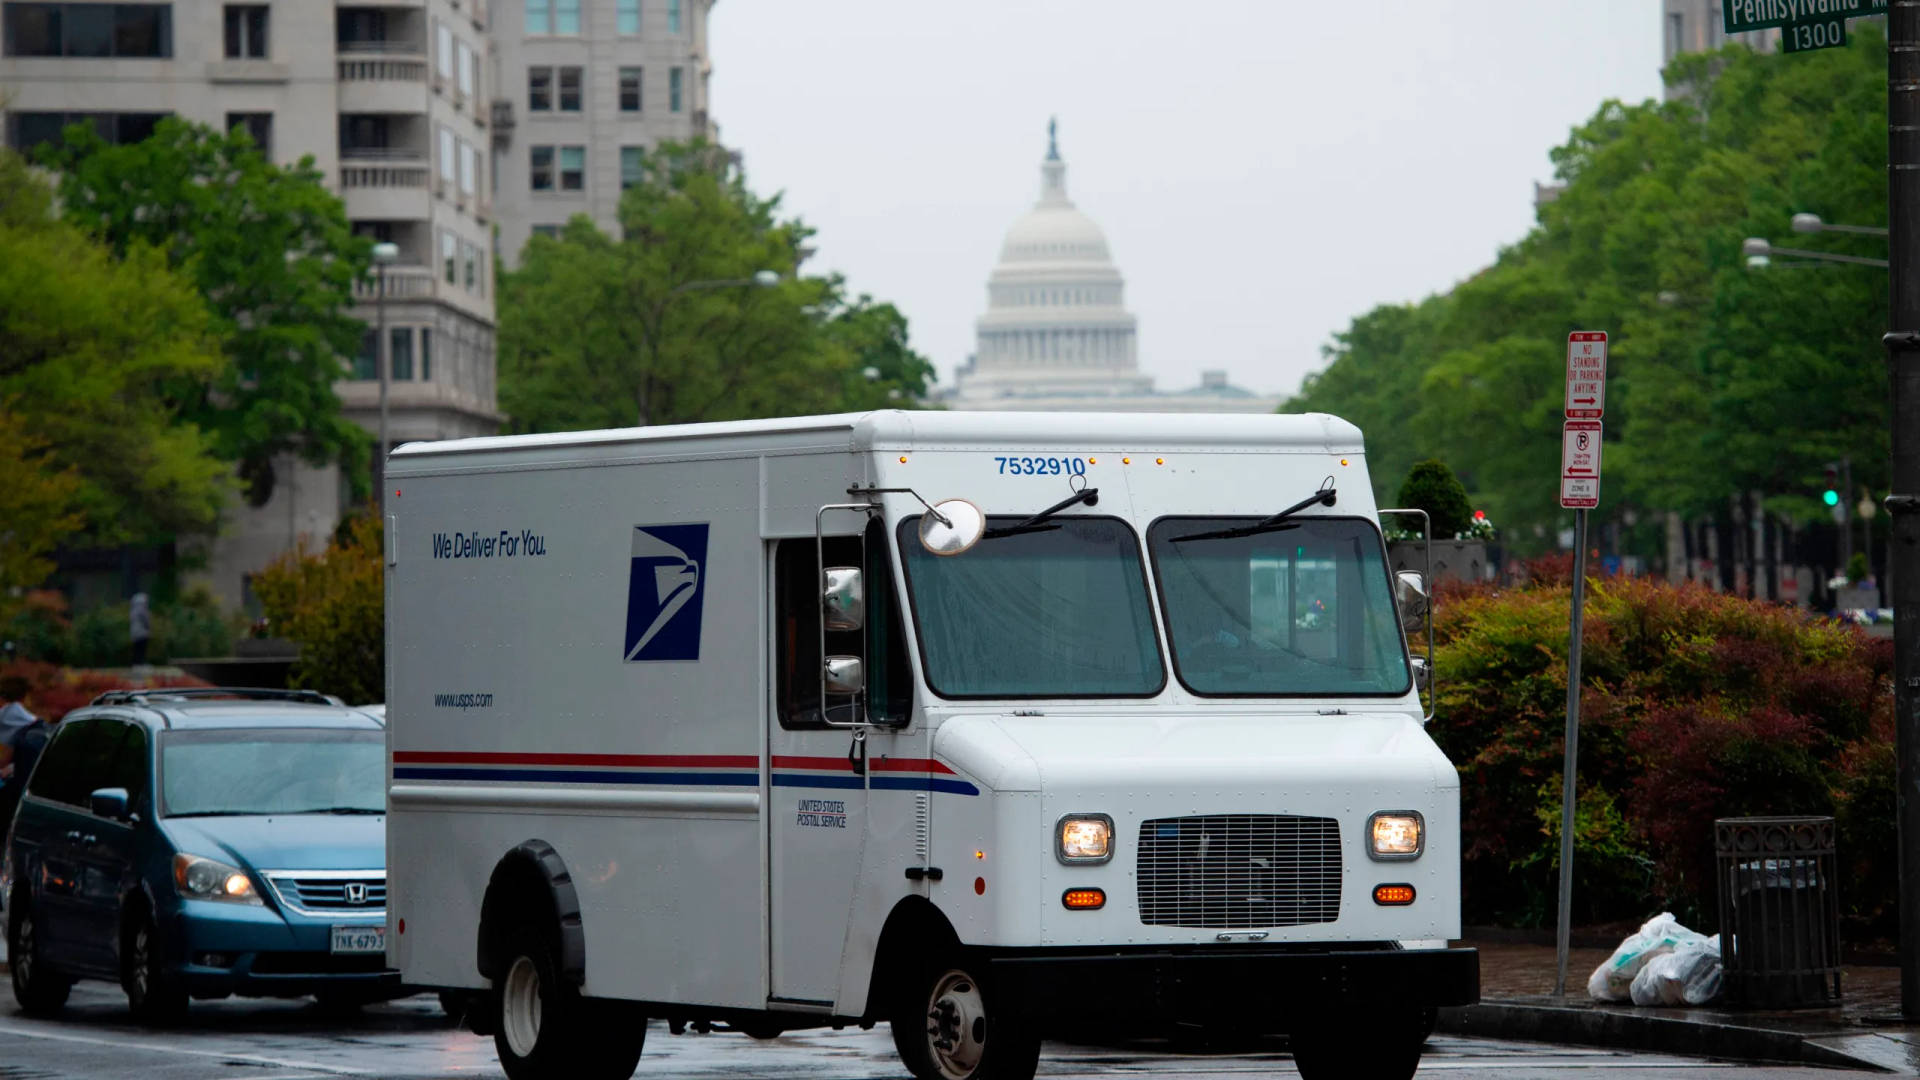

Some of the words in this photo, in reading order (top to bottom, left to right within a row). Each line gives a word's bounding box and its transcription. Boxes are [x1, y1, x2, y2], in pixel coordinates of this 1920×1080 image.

[1792, 21, 1840, 49] 1300
[1583, 344, 1592, 355] NO
[1573, 357, 1600, 368] STANDING
[1580, 370, 1603, 381] PARKING
[1574, 383, 1597, 394] ANYTIME
[994, 457, 1086, 475] 7532910
[433, 533, 452, 559] We
[454, 531, 497, 558] Deliver
[498, 530, 520, 557] For
[521, 529, 546, 556] You.
[434, 693, 493, 712] www.usps.com
[798, 800, 822, 812] UNITED
[822, 800, 844, 813] STATES
[796, 813, 820, 827] POSTAL
[821, 815, 846, 829] SERVICE
